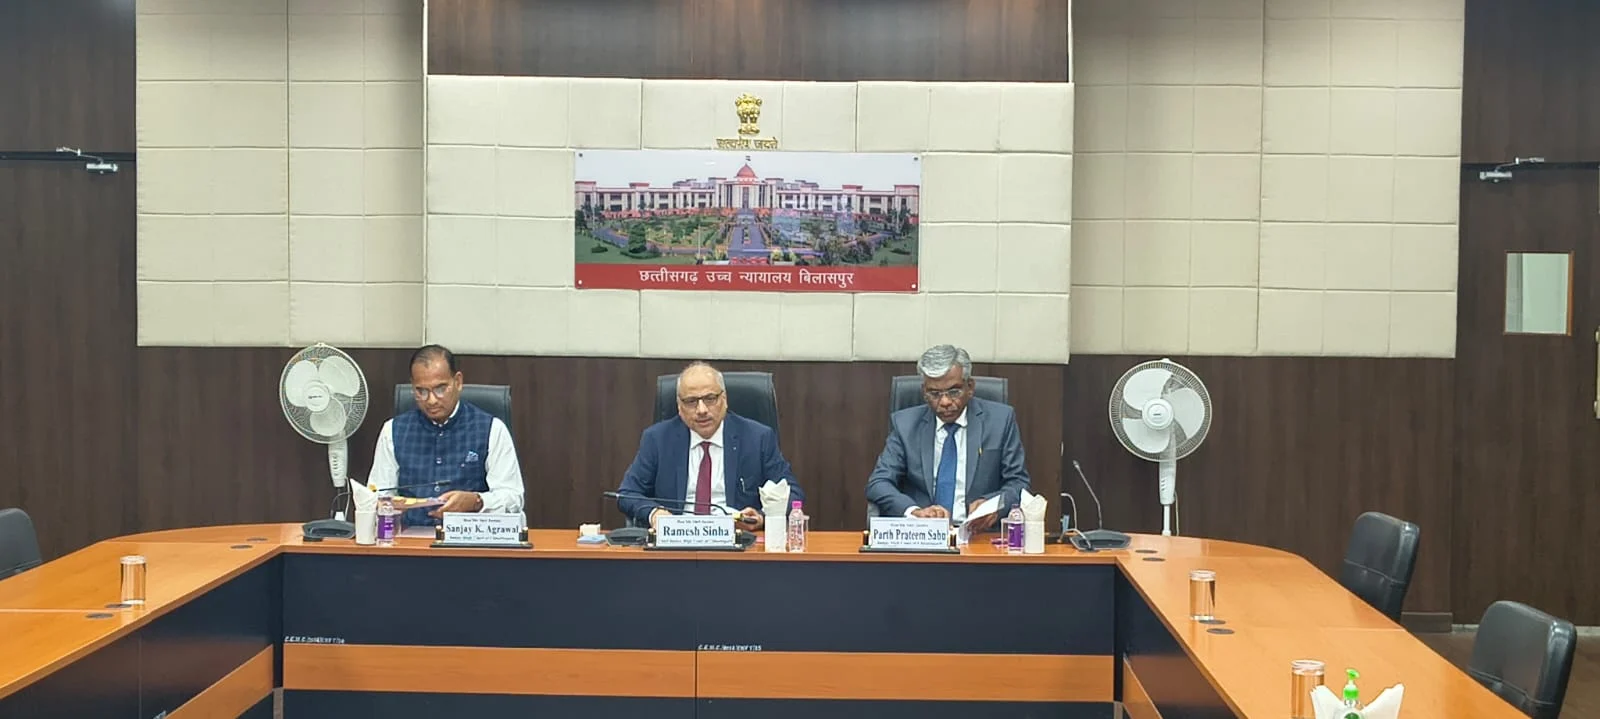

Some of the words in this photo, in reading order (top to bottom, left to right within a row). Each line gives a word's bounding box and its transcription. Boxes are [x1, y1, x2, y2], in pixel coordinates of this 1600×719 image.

[639, 267, 698, 285] छत्तीसगढ़
[705, 270, 732, 283] उच्च
[739, 271, 792, 284] न्यायालय
[799, 268, 854, 288] बिलासपुर
[446, 524, 472, 535] Sanjay
[475, 524, 484, 533] K.
[487, 524, 519, 535] Agrawal
[663, 526, 700, 536] Ramesh
[702, 526, 729, 536] Sinha
[873, 529, 894, 540] Parth
[896, 529, 926, 540] Prateem
